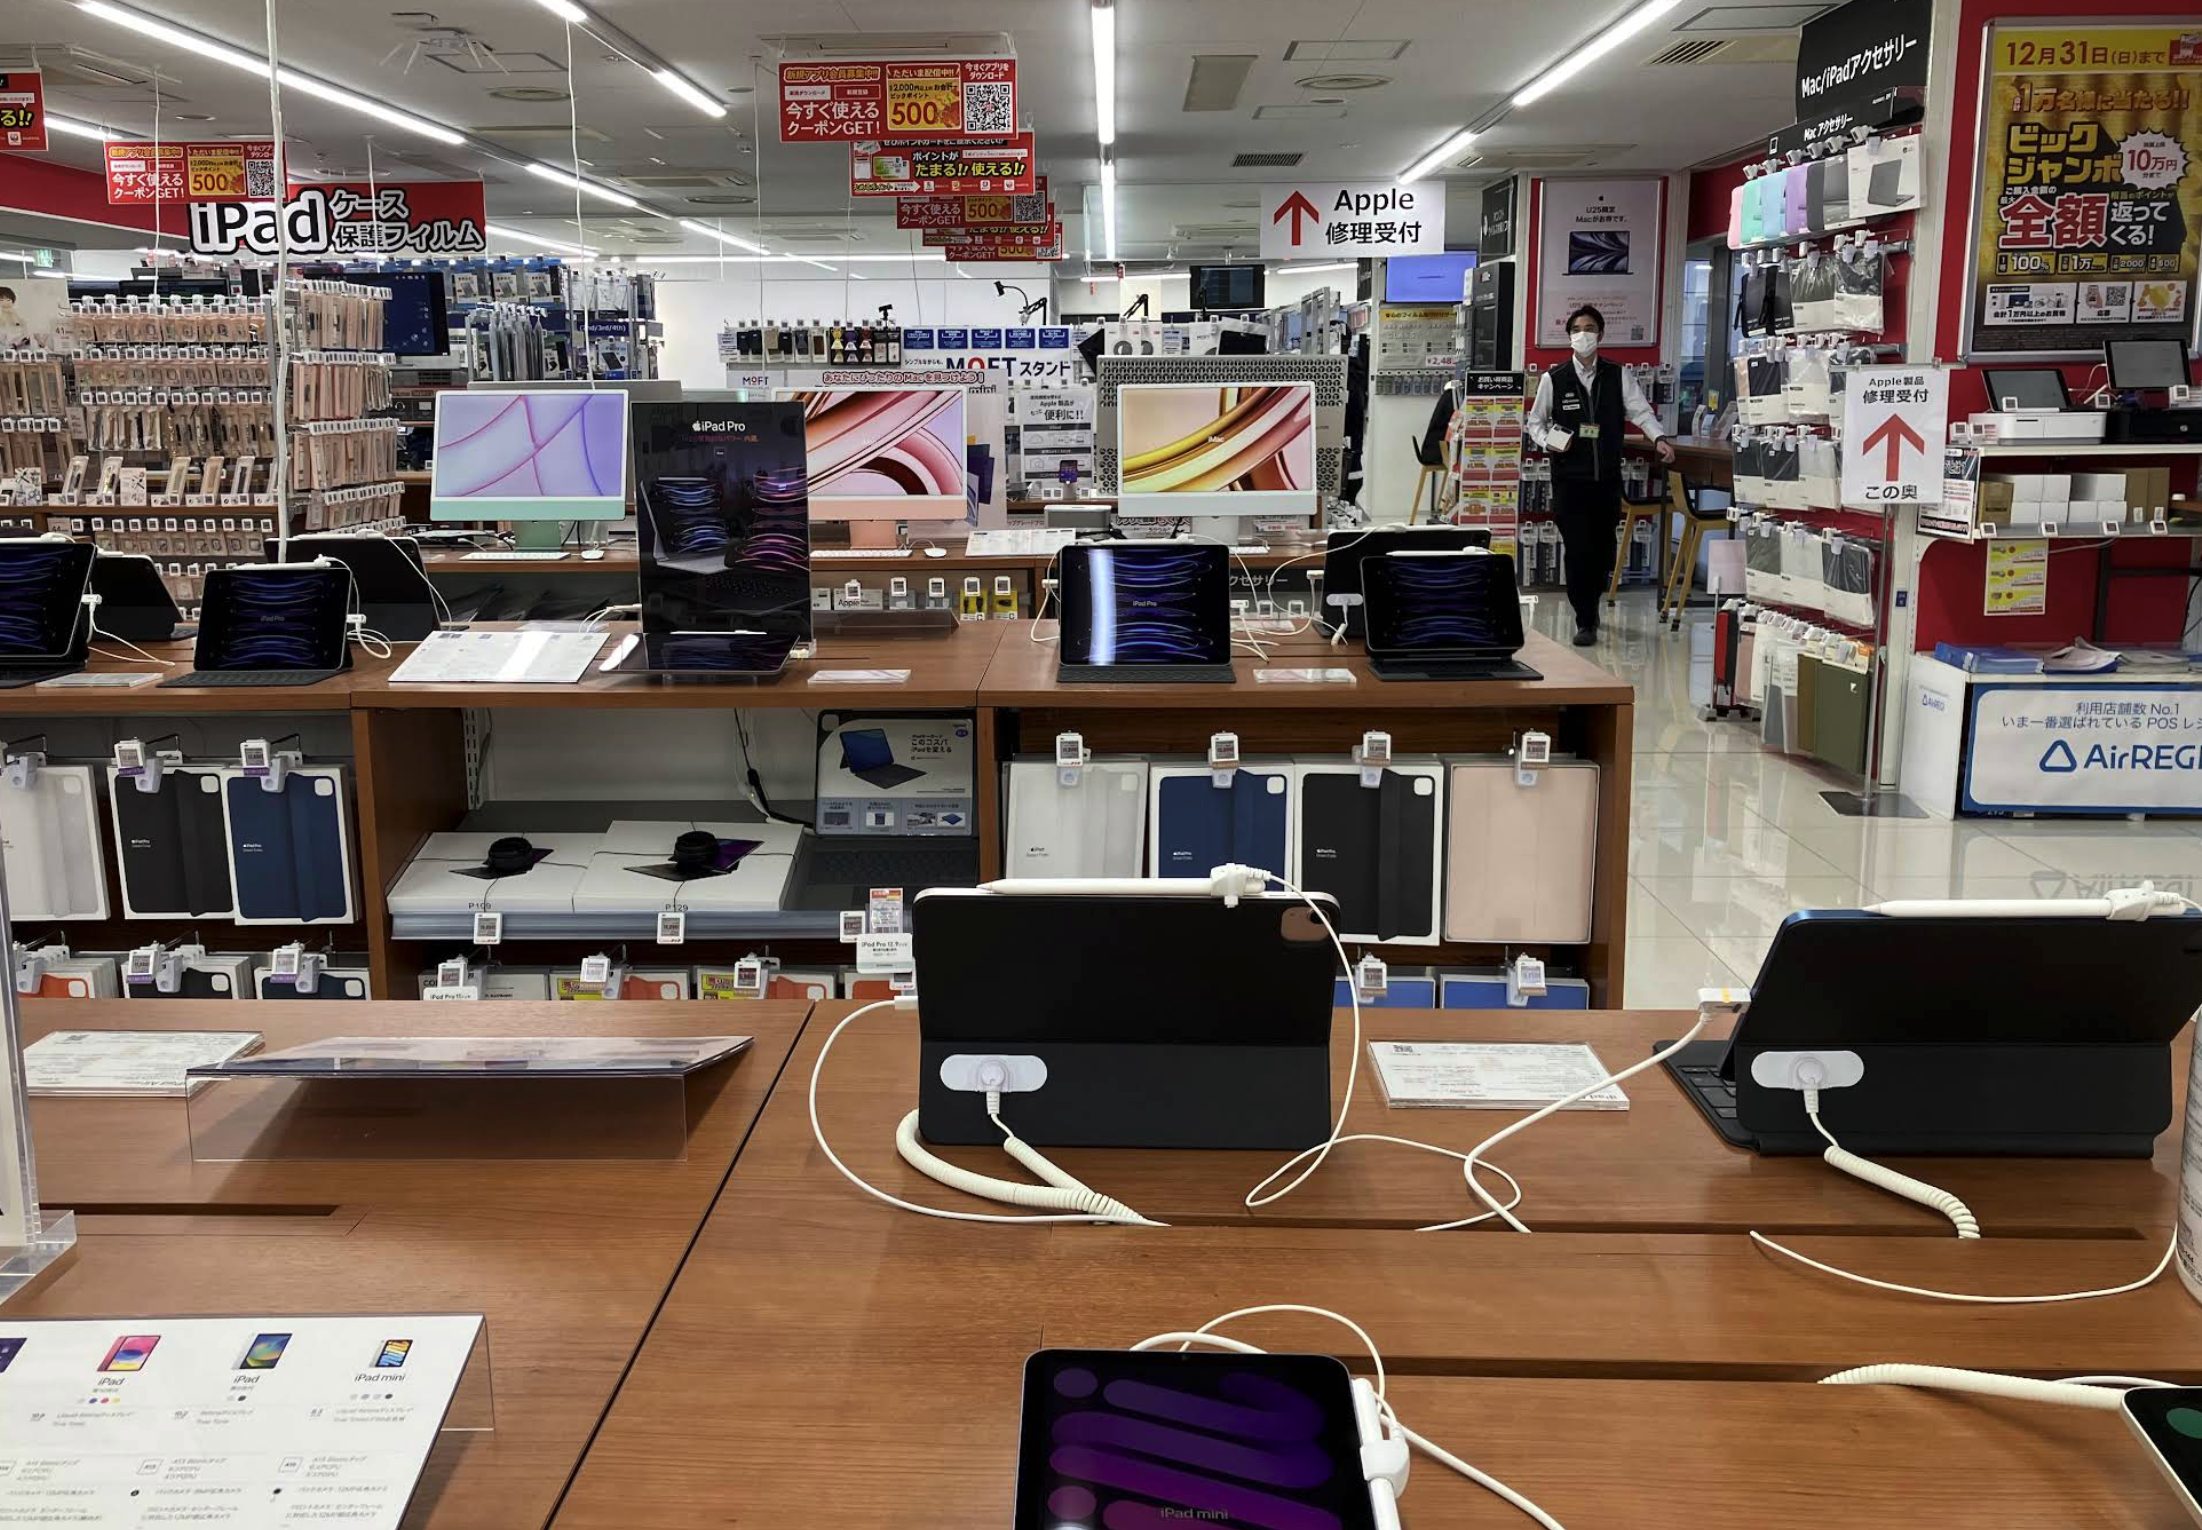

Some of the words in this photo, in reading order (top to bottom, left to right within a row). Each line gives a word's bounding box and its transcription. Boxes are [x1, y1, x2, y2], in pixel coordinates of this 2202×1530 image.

[1801, 33, 1918, 99] Mac/iPadアクセサリー
[786, 101, 880, 119] 今すぐ使える
[891, 101, 937, 125] 500
[786, 121, 880, 135] クーポンGET!
[1818, 113, 1854, 138] アクセサリー
[2009, 122, 2100, 154] ビック
[912, 150, 960, 162] ポイントが
[2127, 149, 2178, 171] 10万円
[2006, 152, 2123, 186] ジャンボ
[112, 172, 184, 187] 今すぐ使える
[192, 173, 229, 191] 500
[900, 203, 961, 215] 今すぐ使える
[1333, 188, 1415, 216] Apple
[968, 204, 999, 218] 500
[2110, 201, 2171, 223] 返って
[190, 190, 329, 255] iPad
[331, 189, 410, 219] ケース
[1999, 192, 2110, 249] 全額
[332, 221, 485, 251] 保護フィルム
[1325, 221, 1422, 245] 修理受付
[2110, 225, 2154, 246] くる!
[1019, 360, 1072, 377] スタンド
[1863, 388, 1930, 404] 修理受付
[701, 420, 726, 432] iPad
[727, 420, 746, 432] Pro
[1865, 484, 1918, 500] この奥
[2076, 701, 2147, 716] 利用店舗数
[2002, 715, 2143, 730] いま一番選ばれている
[2146, 716, 2179, 730] POS
[97, 1377, 126, 1386] iPad
[233, 1375, 261, 1384] iPad
[353, 1373, 381, 1382] iPad
[381, 1373, 406, 1382] mini
[1160, 1506, 1194, 1519] iPad
[1196, 1508, 1229, 1520] mini
